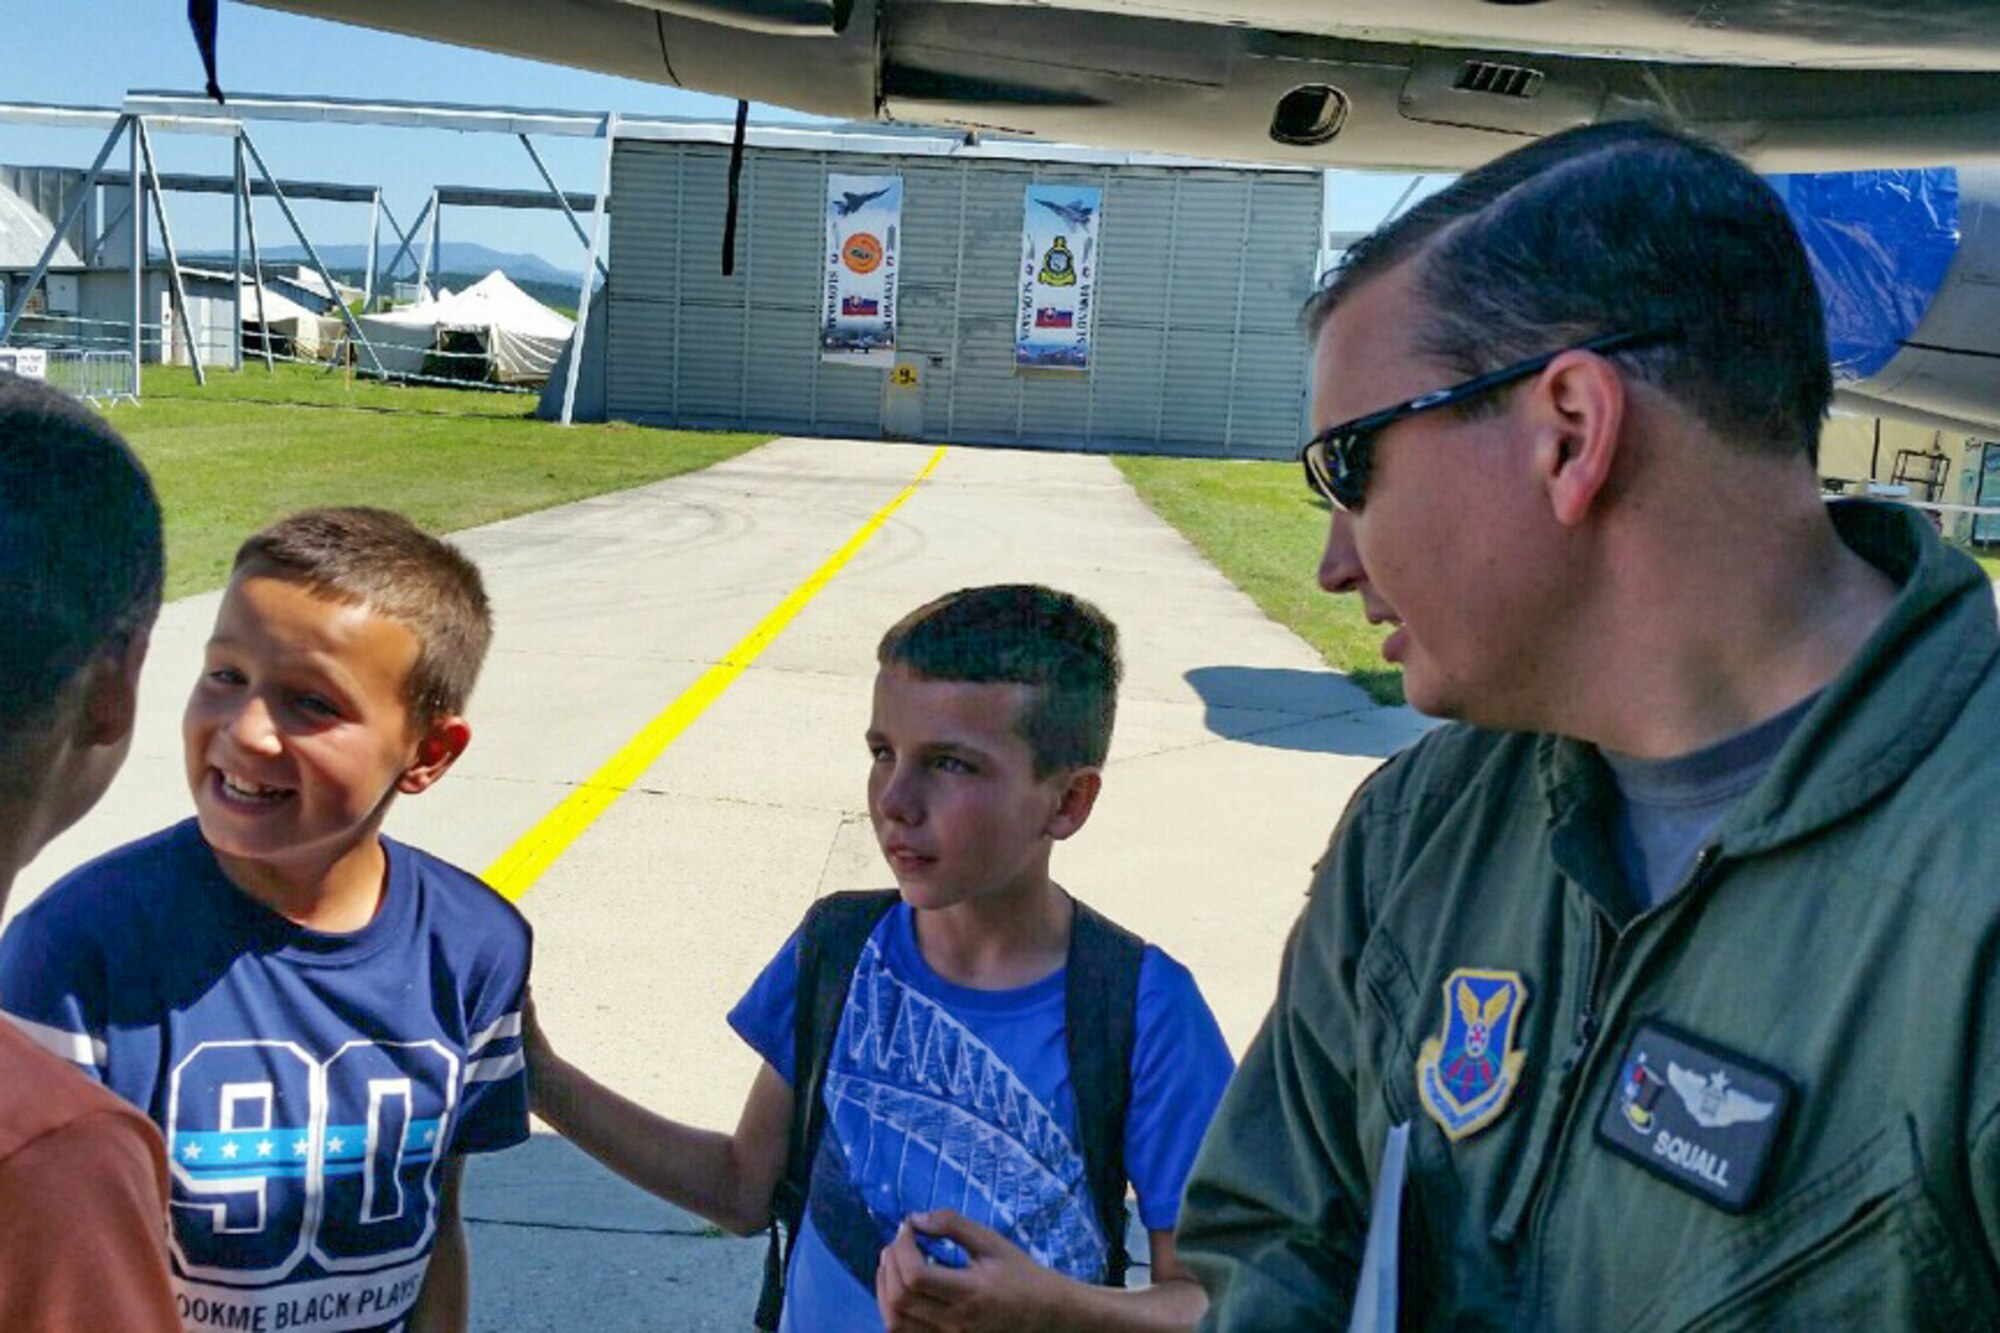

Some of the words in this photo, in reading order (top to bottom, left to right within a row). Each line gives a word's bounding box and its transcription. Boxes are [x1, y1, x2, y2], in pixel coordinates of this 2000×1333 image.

[168, 1039, 459, 1282] 90
[1652, 1130, 1729, 1188] SQUALL
[275, 1293, 350, 1329] BLACK
